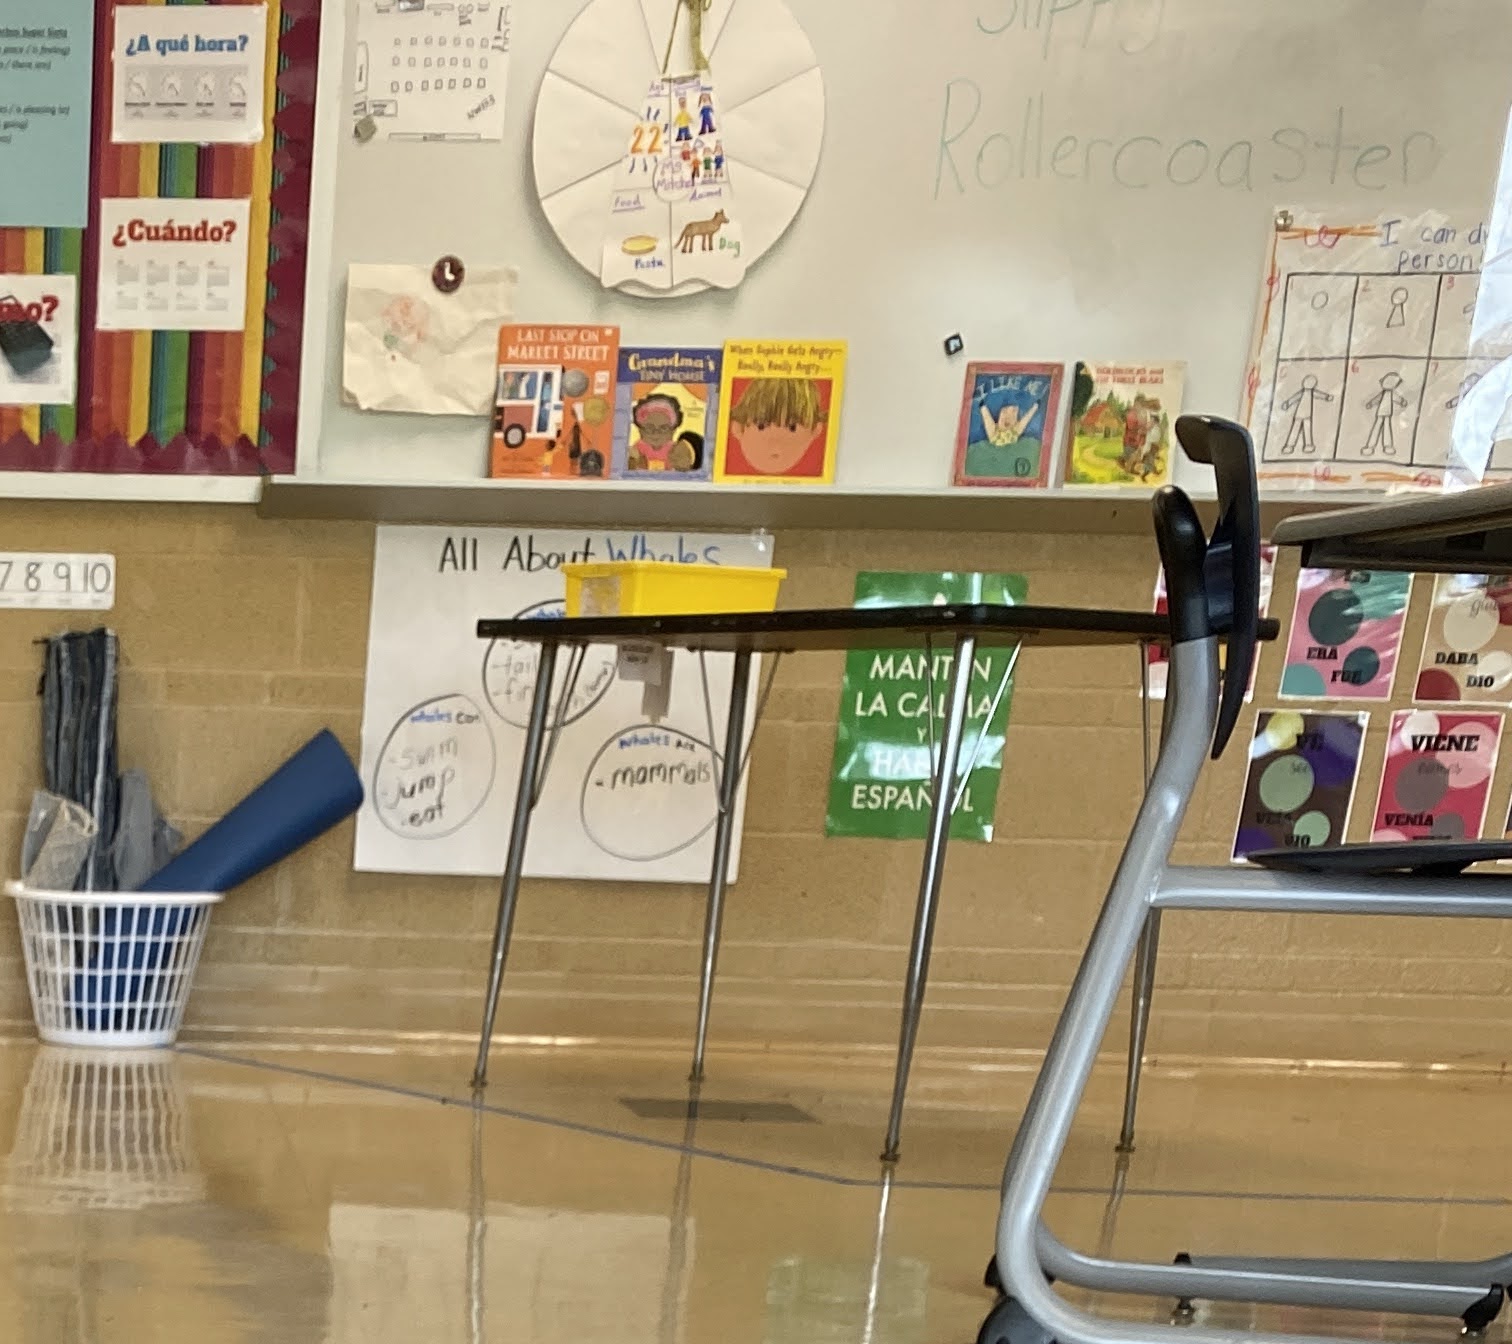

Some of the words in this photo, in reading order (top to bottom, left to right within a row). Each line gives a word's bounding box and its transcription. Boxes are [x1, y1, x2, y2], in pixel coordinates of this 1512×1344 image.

[126, 34, 151, 56] ¿A
[156, 33, 189, 56] qué
[195, 34, 249, 52] hora?
[630, 125, 662, 154] 22
[934, 77, 1443, 201] Rollercoaster
[112, 218, 236, 247] ¿Cuándo?
[1380, 219, 1401, 247] I
[1421, 226, 1456, 244] can
[719, 236, 741, 258] Dog
[516, 328, 545, 342] LAST
[549, 328, 577, 342] STOP
[580, 329, 600, 343] ON
[507, 345, 560, 361] MARKET
[563, 345, 609, 361] STREET
[627, 352, 716, 373] Grandma's
[438, 536, 478, 572] All
[502, 534, 595, 572] About
[24, 562, 40, 592] 8
[54, 562, 71, 592] 9
[83, 562, 112, 593] 10
[869, 653, 992, 682] MANTN
[1466, 674, 1495, 688] DIO
[854, 691, 888, 717] LA
[1411, 734, 1481, 752] VIENE
[851, 780, 975, 813] ESPAÑL
[1384, 810, 1434, 827] VENÍA
